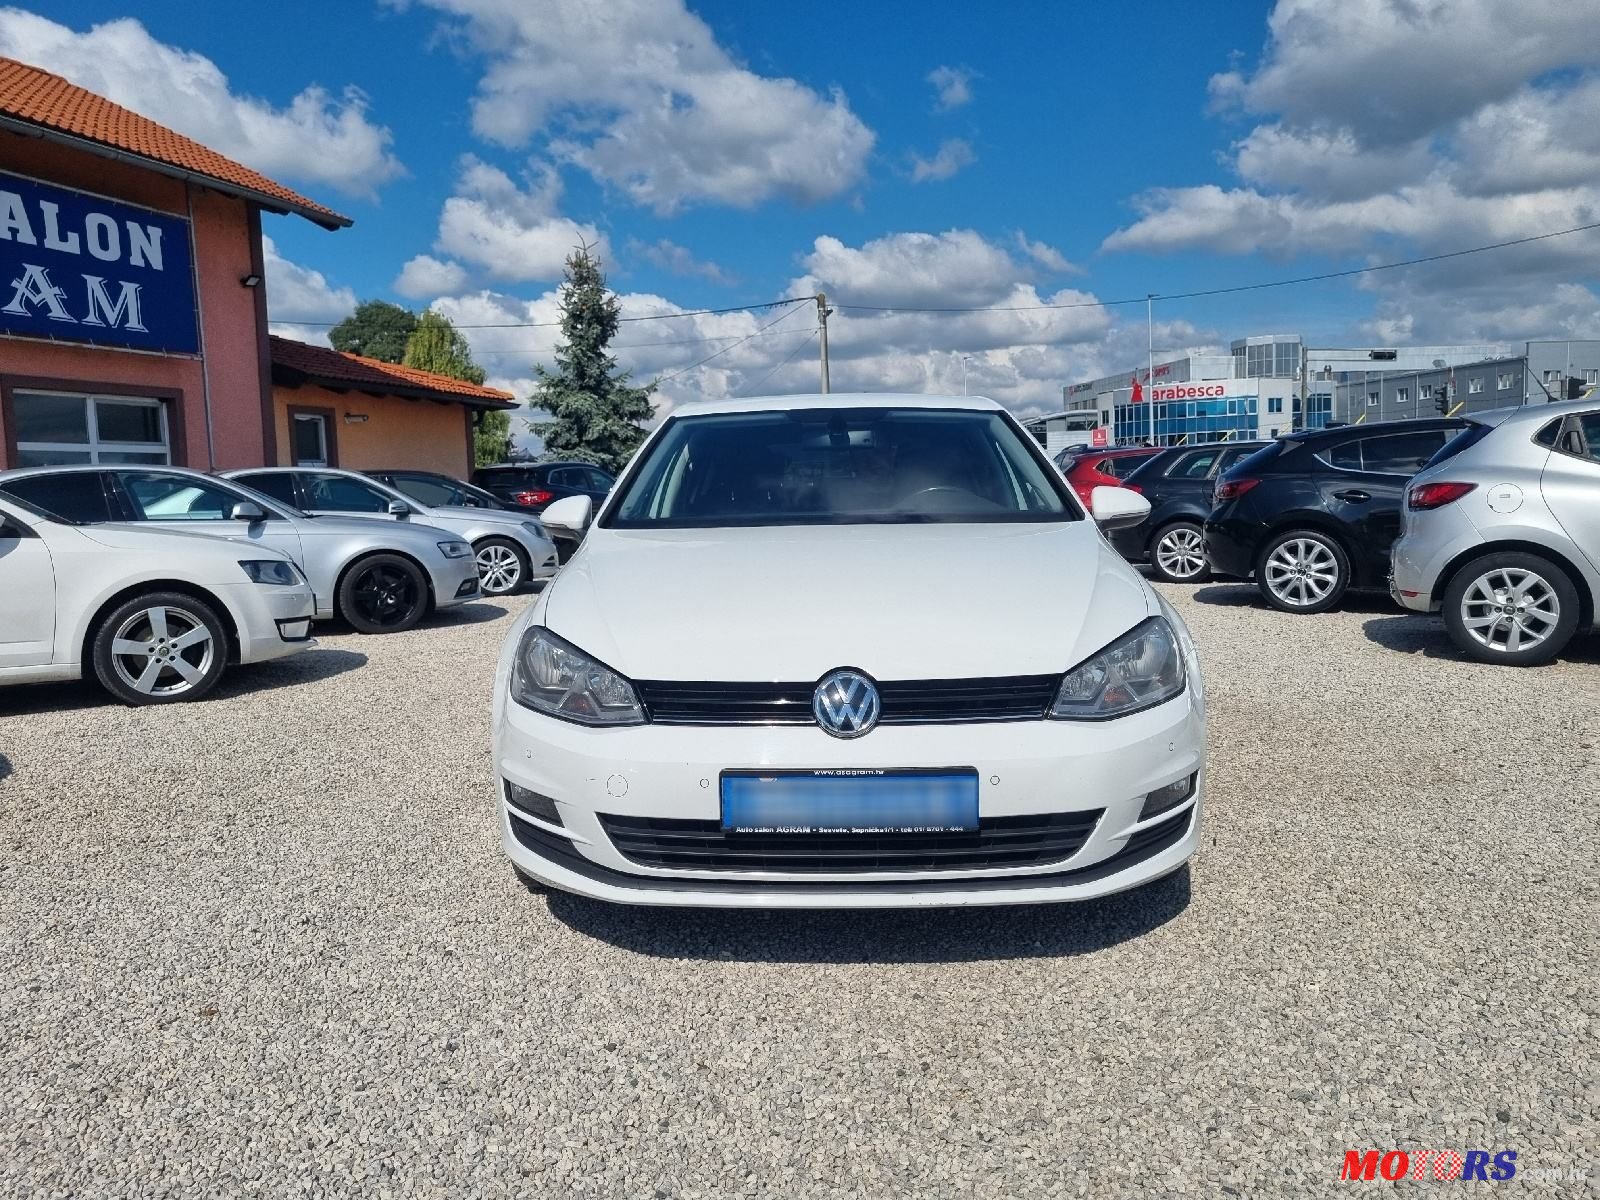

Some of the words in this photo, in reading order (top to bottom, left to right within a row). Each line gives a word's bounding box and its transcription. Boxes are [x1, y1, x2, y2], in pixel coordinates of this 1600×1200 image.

[0, 190, 164, 271] ALON
[1, 263, 149, 333] AM
[1152, 385, 1225, 401] arabesca
